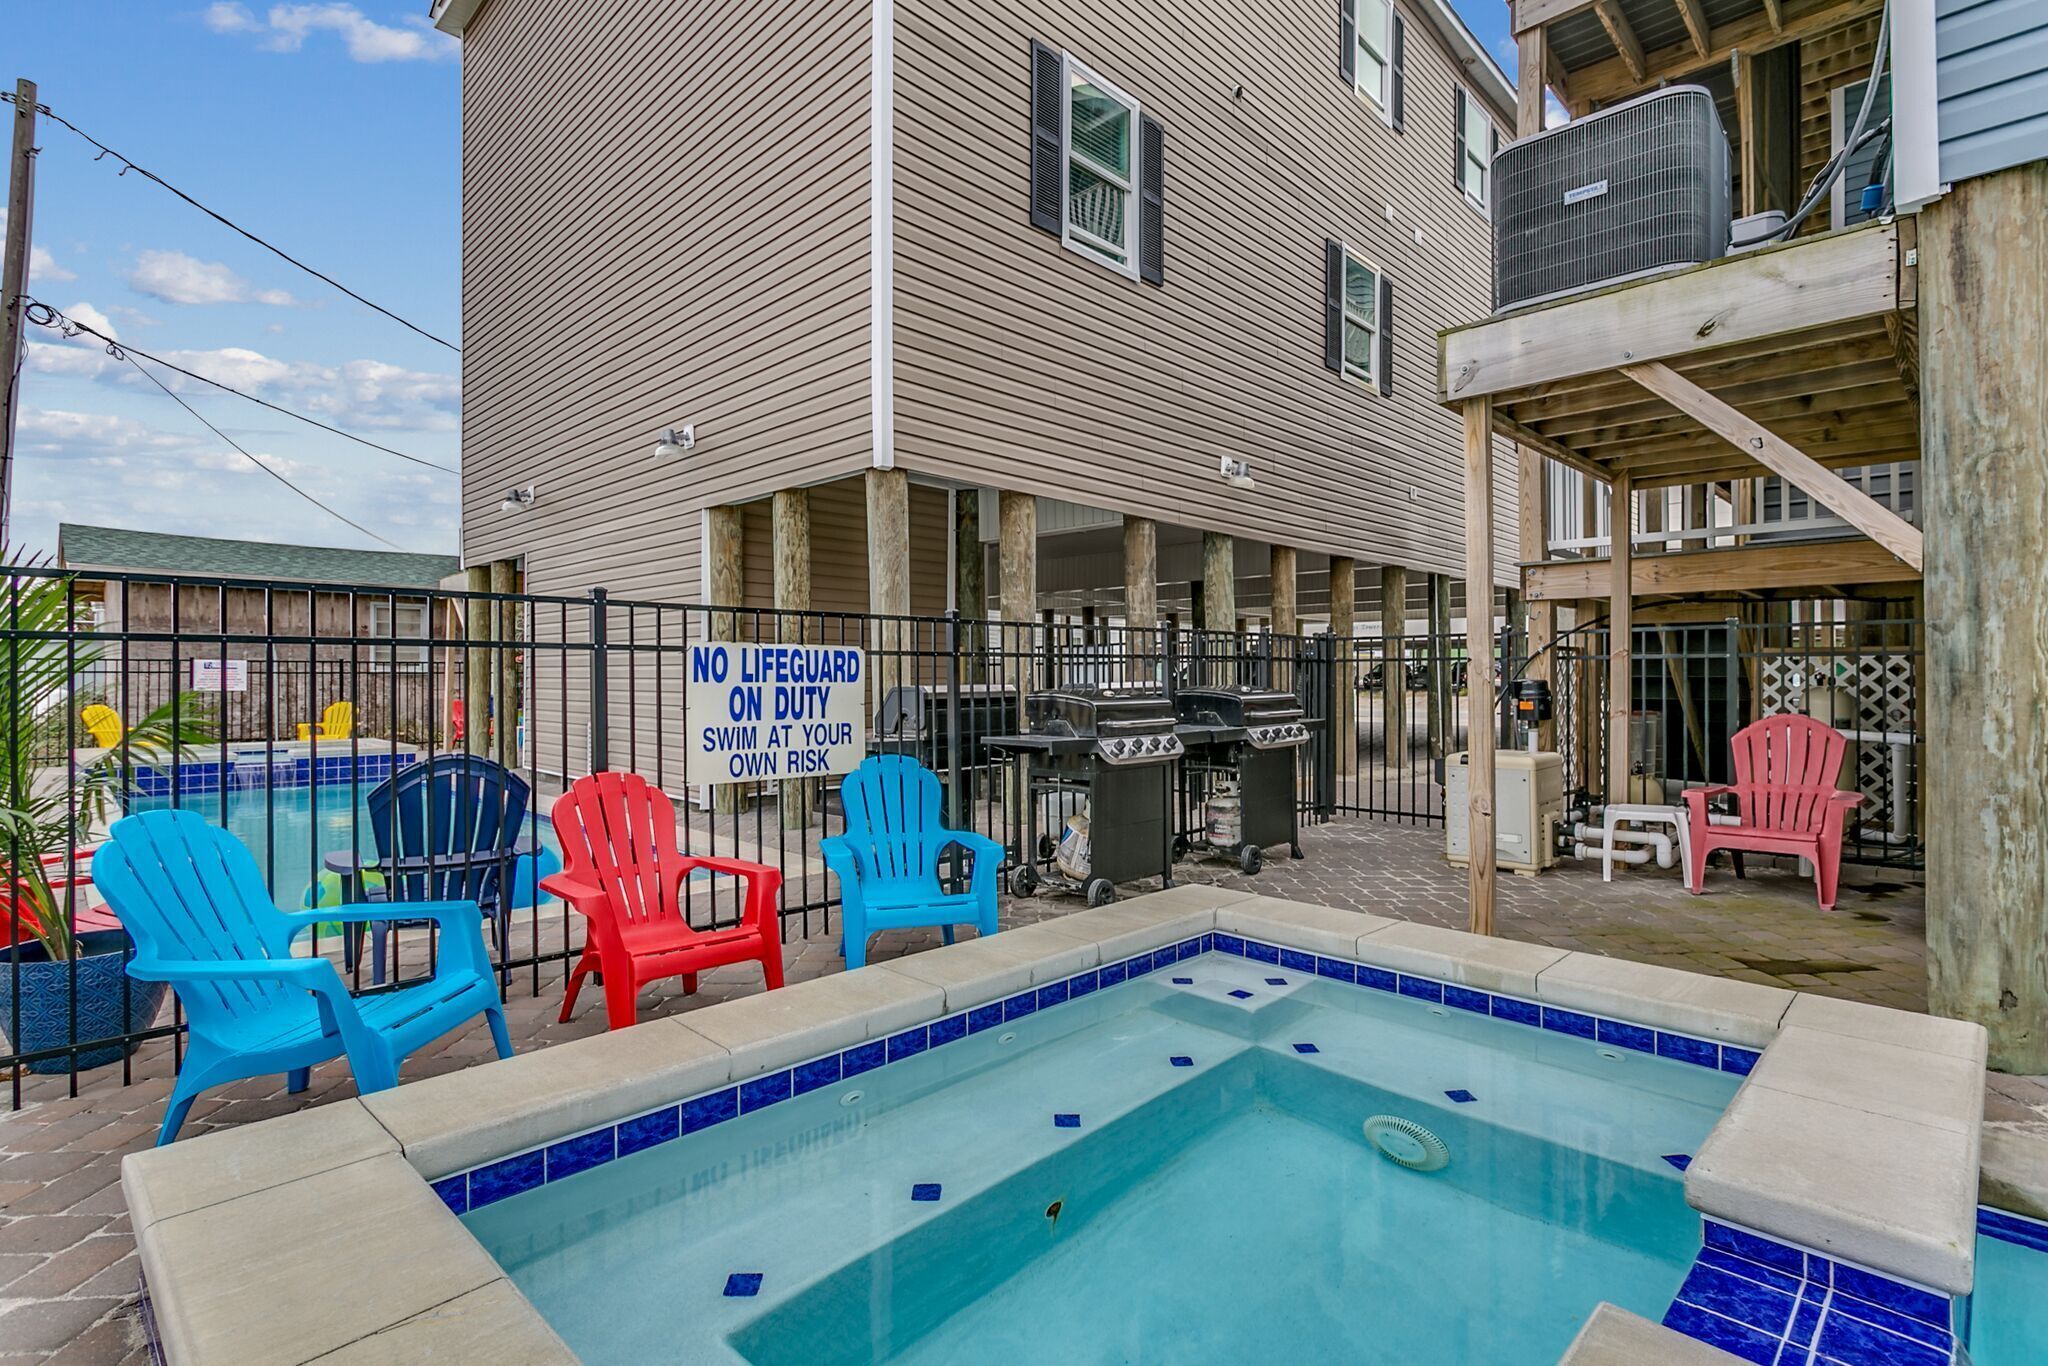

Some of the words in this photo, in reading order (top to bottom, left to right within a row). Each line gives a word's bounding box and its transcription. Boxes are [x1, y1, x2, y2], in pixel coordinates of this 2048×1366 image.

[693, 647, 728, 683] NO
[741, 648, 860, 683] LIFEGUARD
[729, 686, 762, 722] ON
[775, 686, 831, 720] DUTY
[703, 726, 757, 752] SWIM
[768, 725, 792, 749] AT
[803, 723, 852, 746] YOUR
[729, 752, 777, 778] OWN
[787, 749, 830, 773] RISK
